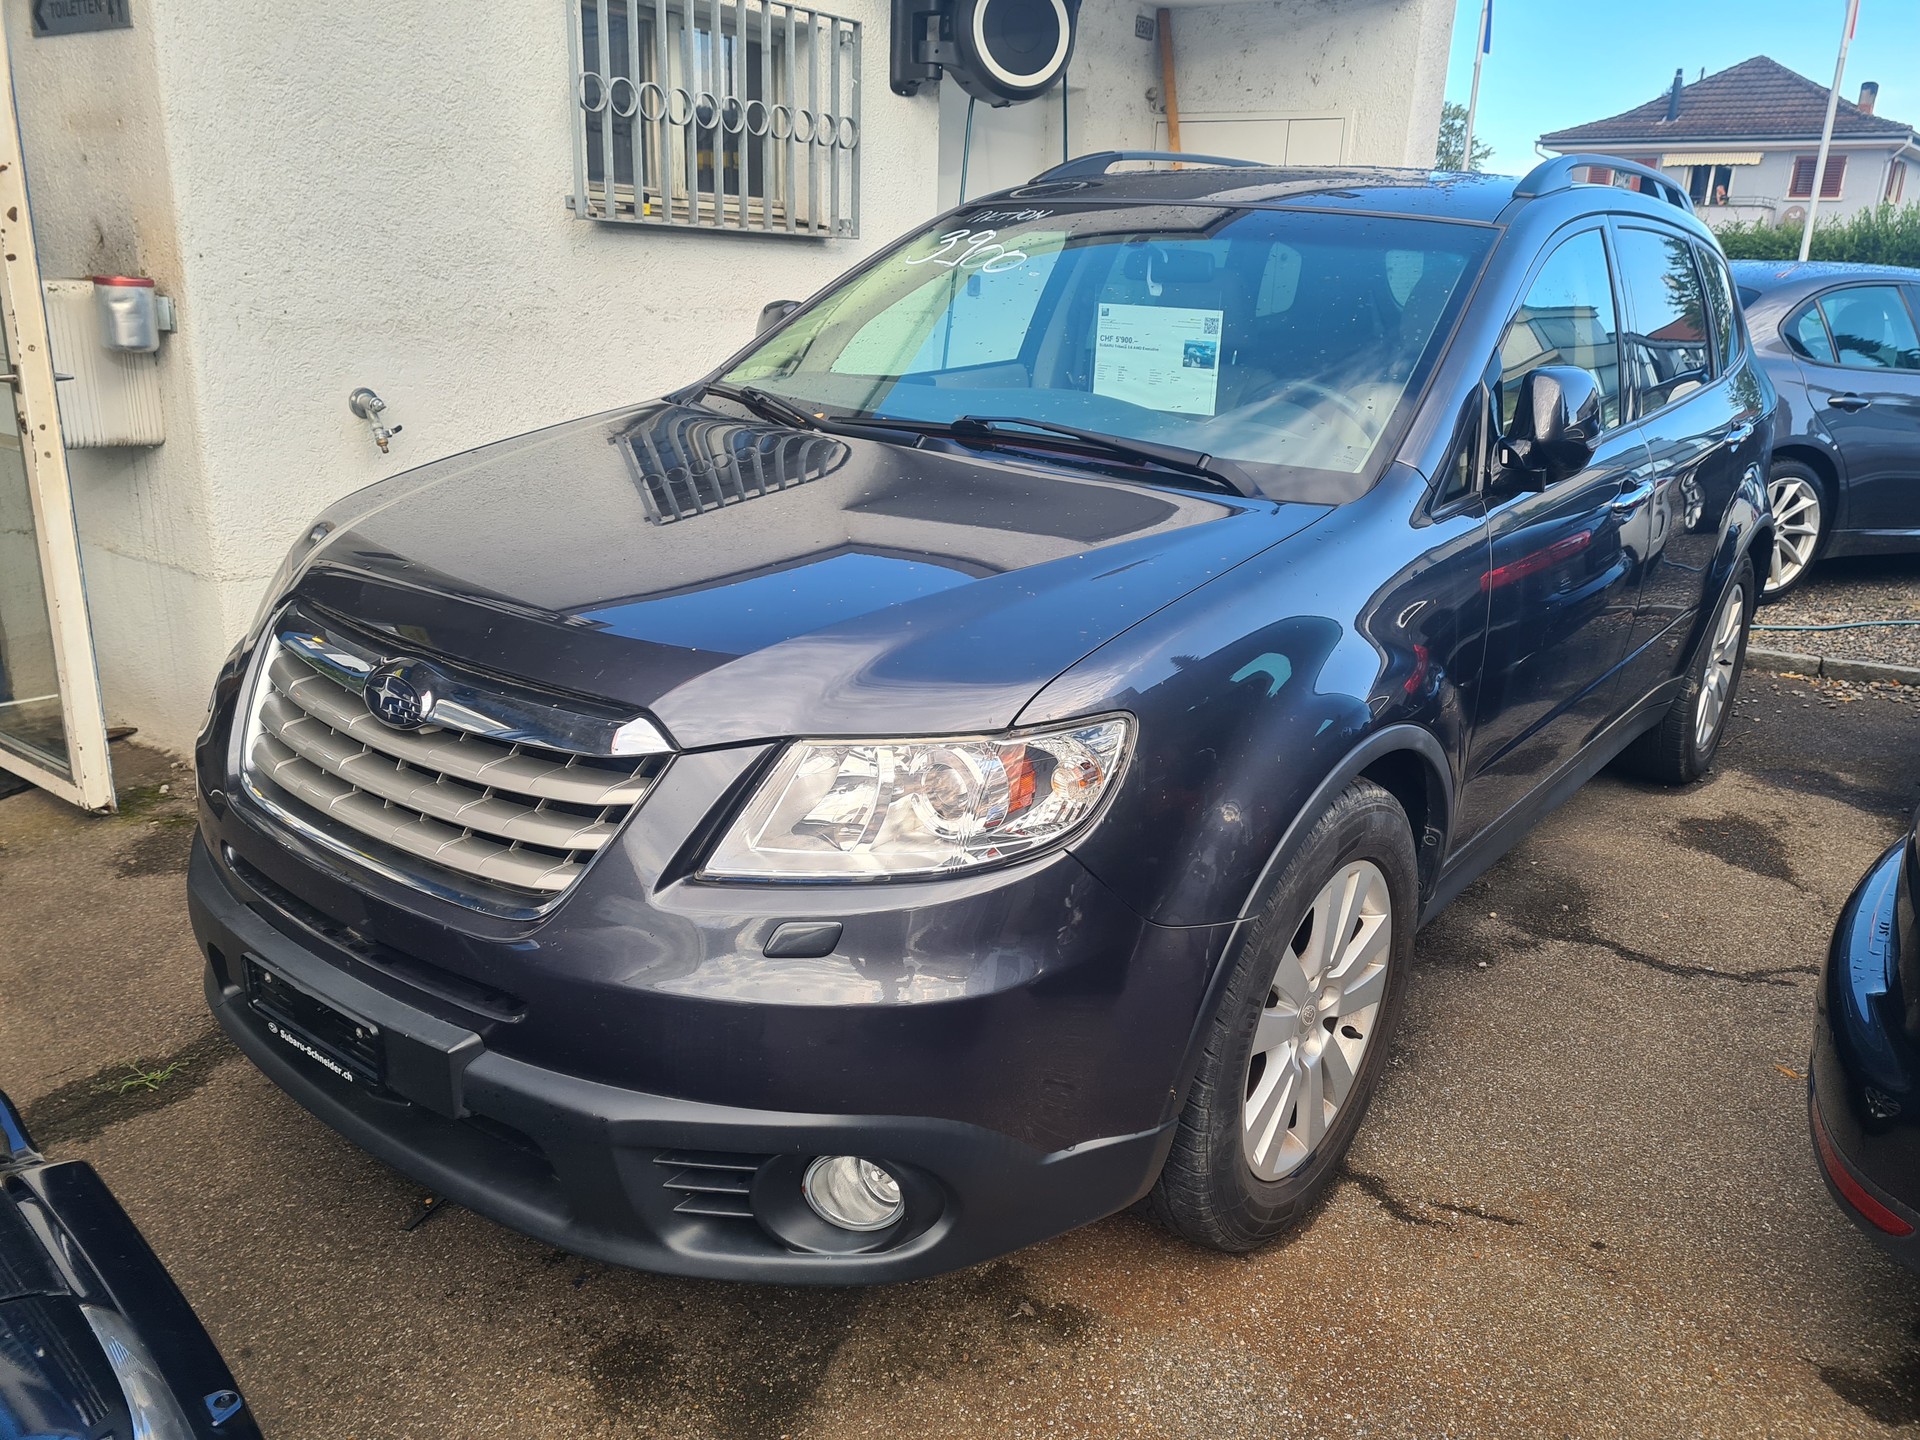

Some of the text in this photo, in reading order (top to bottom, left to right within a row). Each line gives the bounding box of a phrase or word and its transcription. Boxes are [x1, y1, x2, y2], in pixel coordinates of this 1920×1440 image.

[49, 0, 102, 18] TOILETTEN
[1100, 334, 1114, 342] CHF
[279, 1029, 353, 1083] Subaru-Schneider.ch
